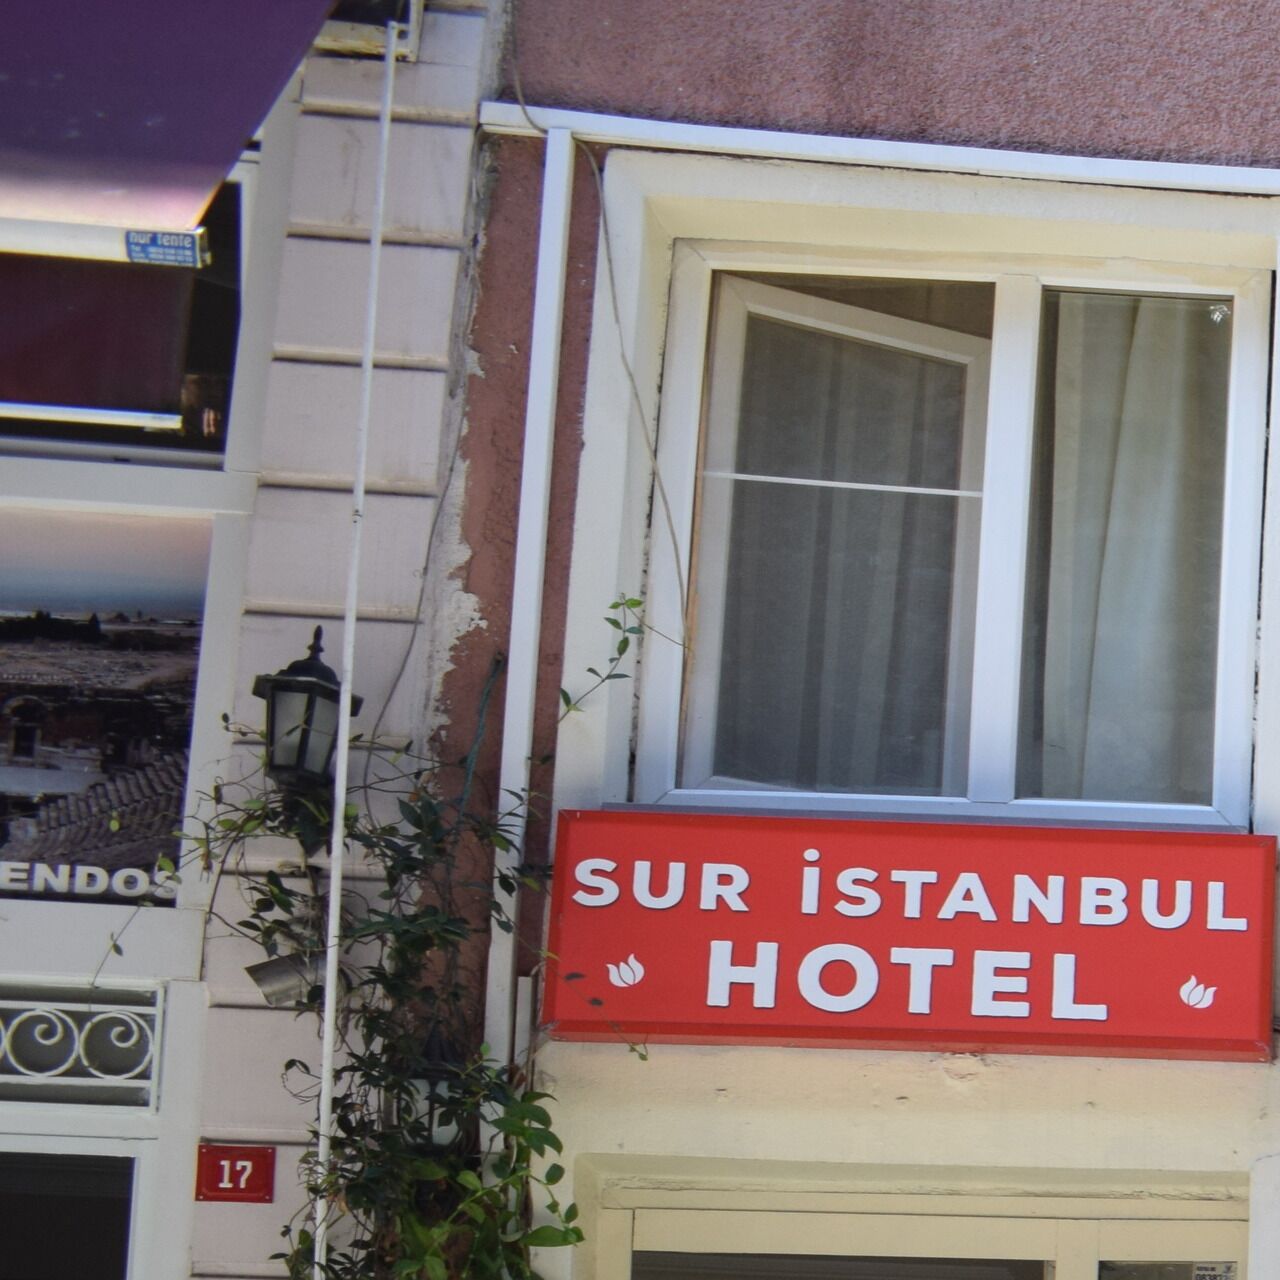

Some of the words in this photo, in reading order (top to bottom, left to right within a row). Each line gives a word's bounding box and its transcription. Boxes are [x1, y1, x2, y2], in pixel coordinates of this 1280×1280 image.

[572, 857, 751, 913] SUR
[801, 848, 1249, 933] İSTANBUL
[705, 938, 1109, 1022] HOTEL
[218, 1160, 253, 1189] 17
